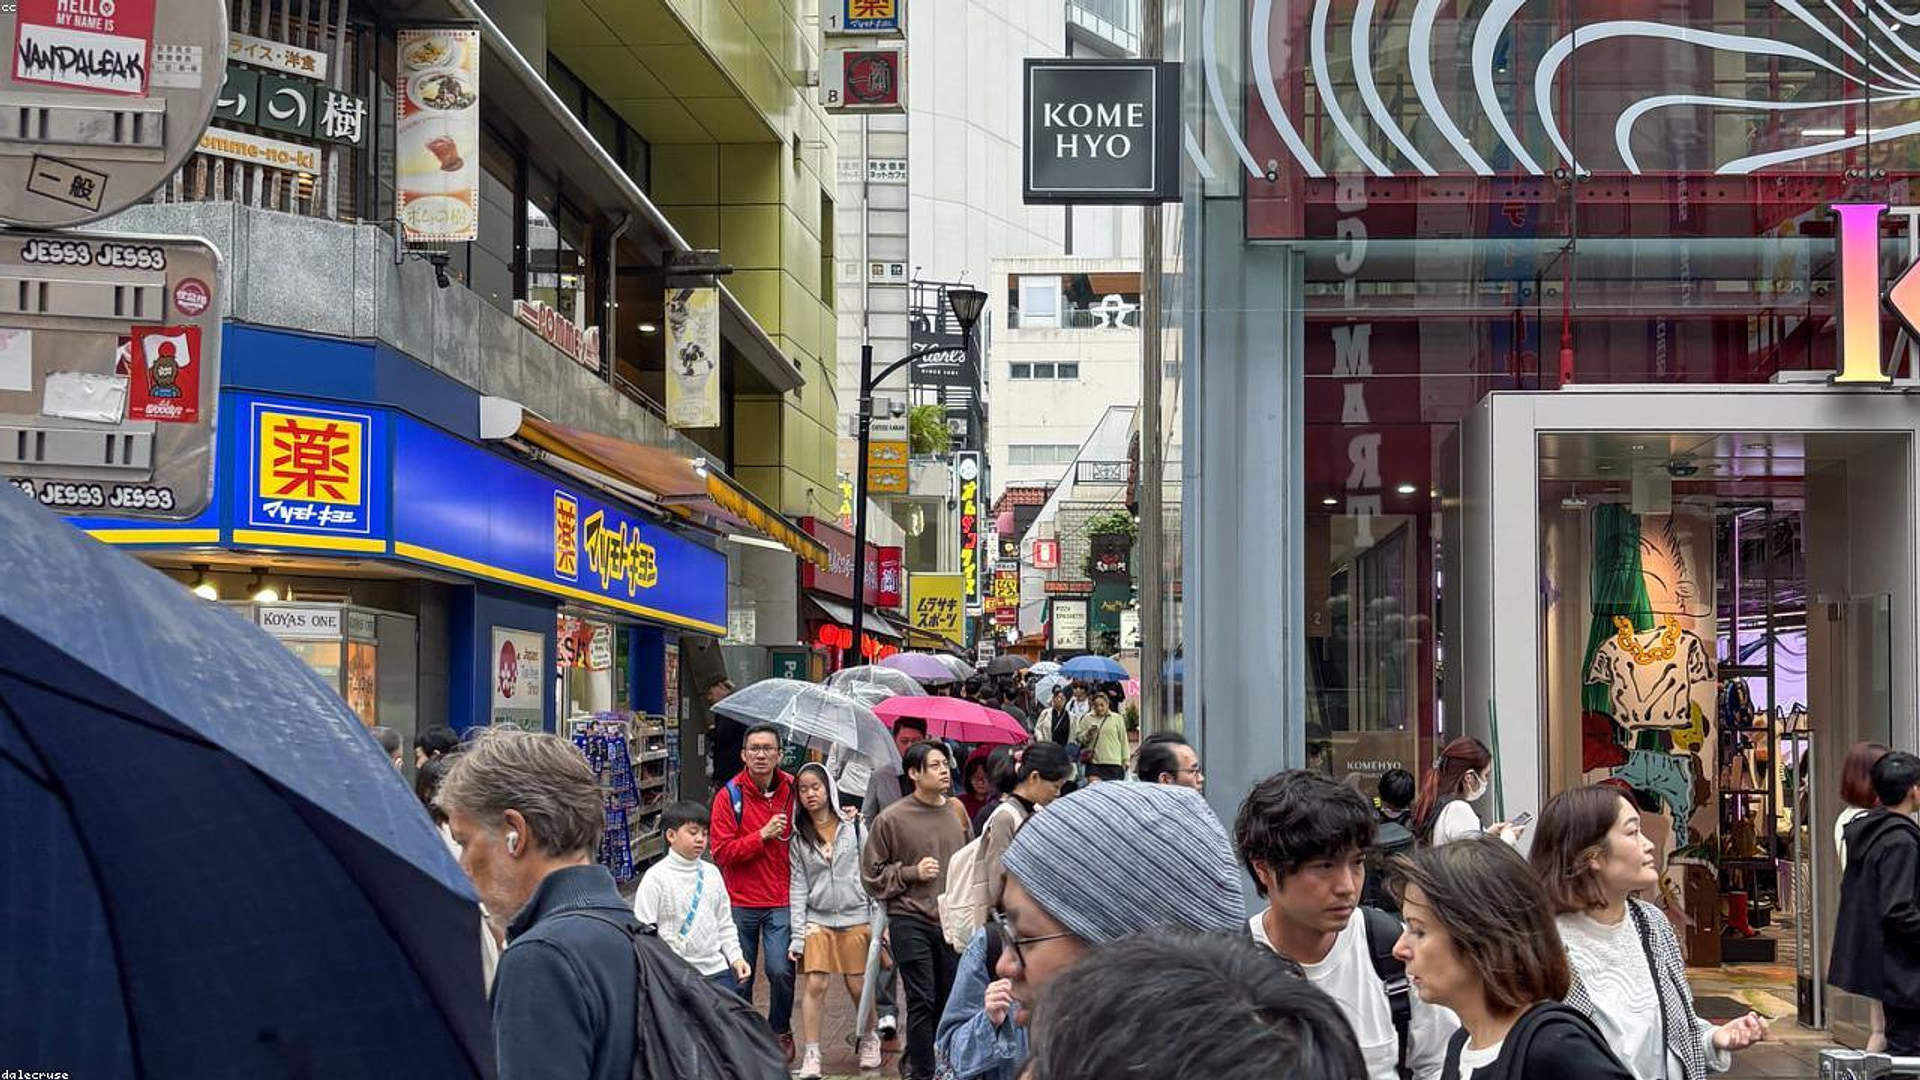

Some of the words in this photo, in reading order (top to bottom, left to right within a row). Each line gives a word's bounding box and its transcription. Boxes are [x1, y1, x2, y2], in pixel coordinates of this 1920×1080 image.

[56, 13, 71, 25] MY
[74, 15, 102, 30] NAME
[104, 19, 114, 32] IS
[1043, 103, 1144, 128] KOME
[1056, 133, 1131, 158] HYO
[38, 172, 95, 202] 一般
[22, 240, 91, 264] JESS3
[96, 244, 165, 270] JESS3
[273, 418, 350, 501] 薬
[40, 484, 104, 506] JESS3
[109, 487, 174, 511] JESS3
[262, 500, 357, 527] マツモトキヨシ
[557, 501, 577, 573] 薬
[584, 509, 658, 598] マツモトキヨシ
[917, 597, 958, 612] ムラサキ
[264, 613, 306, 628] KOYAS
[311, 615, 337, 628] ONE
[916, 612, 957, 628] スポーツ
[1314, 612, 1321, 625] 2
[1346, 760, 1401, 770] KOMEHYO
